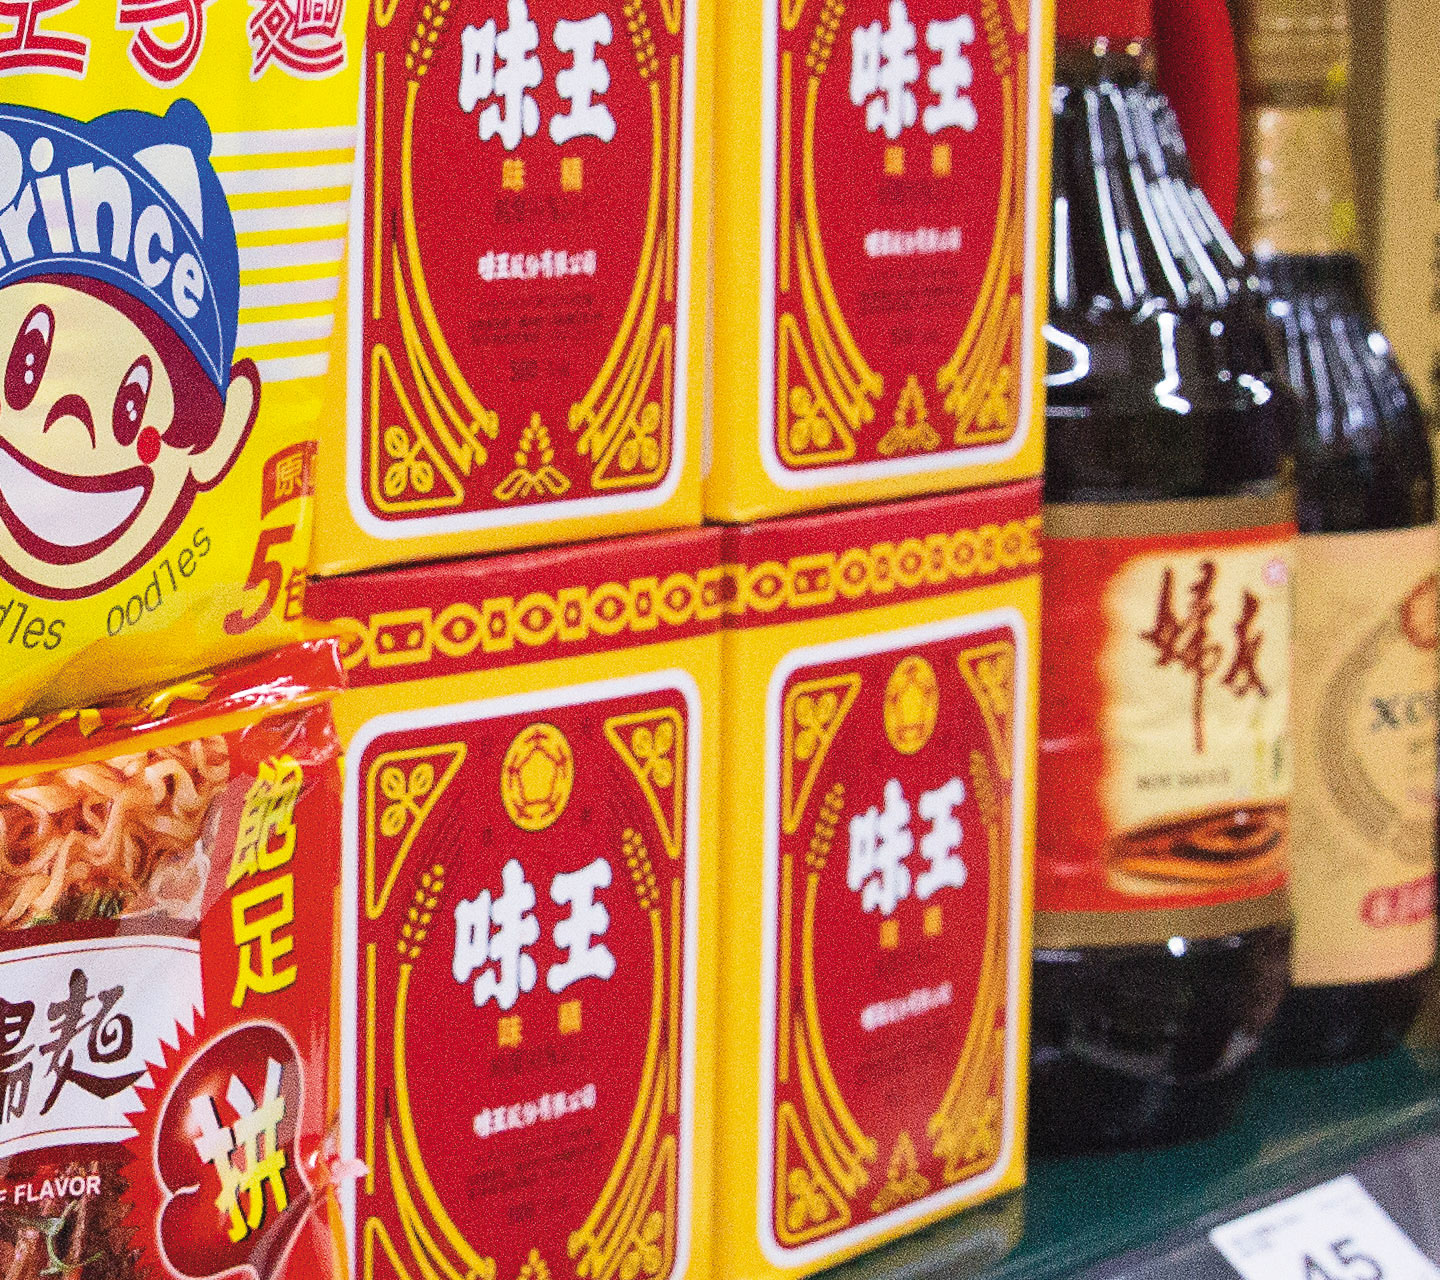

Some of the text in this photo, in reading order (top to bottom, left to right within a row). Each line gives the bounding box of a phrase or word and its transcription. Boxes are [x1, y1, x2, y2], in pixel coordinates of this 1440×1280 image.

[846, 776, 969, 916] 味王
[452, 856, 619, 1011] 味王
[12, 1174, 103, 1209] FLAVOR
